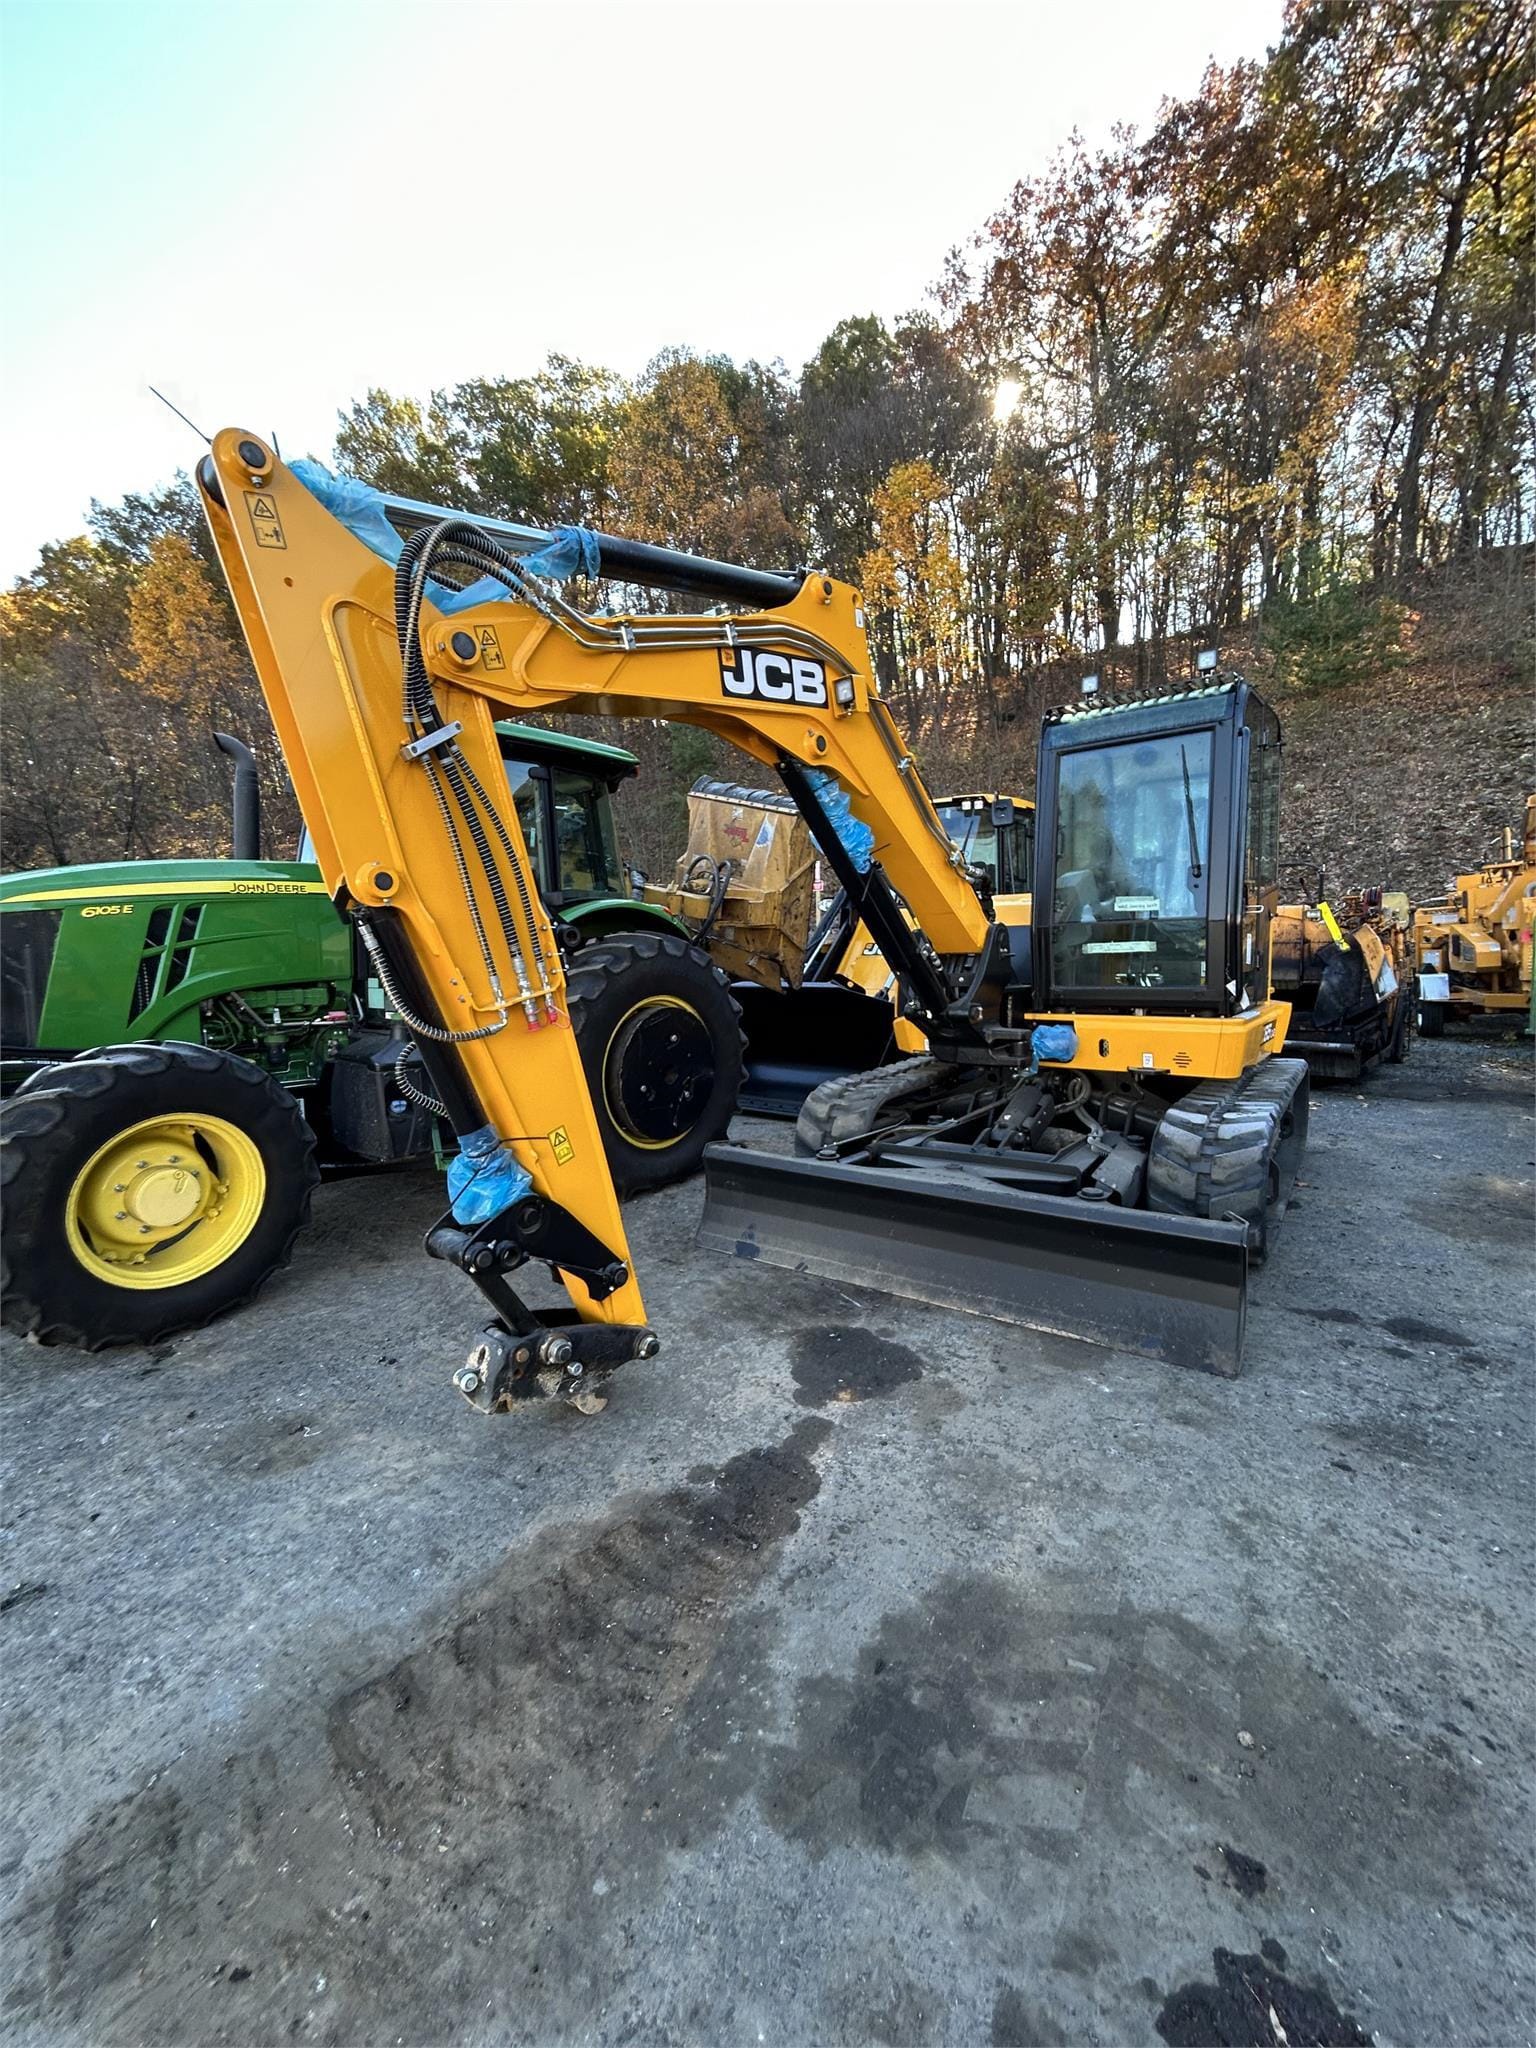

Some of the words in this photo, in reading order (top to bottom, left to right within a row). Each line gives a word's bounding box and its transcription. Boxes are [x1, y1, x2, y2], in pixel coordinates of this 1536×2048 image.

[723, 649, 826, 704] JCB
[230, 882, 265, 892] JOHN
[266, 882, 307, 893] DEERE
